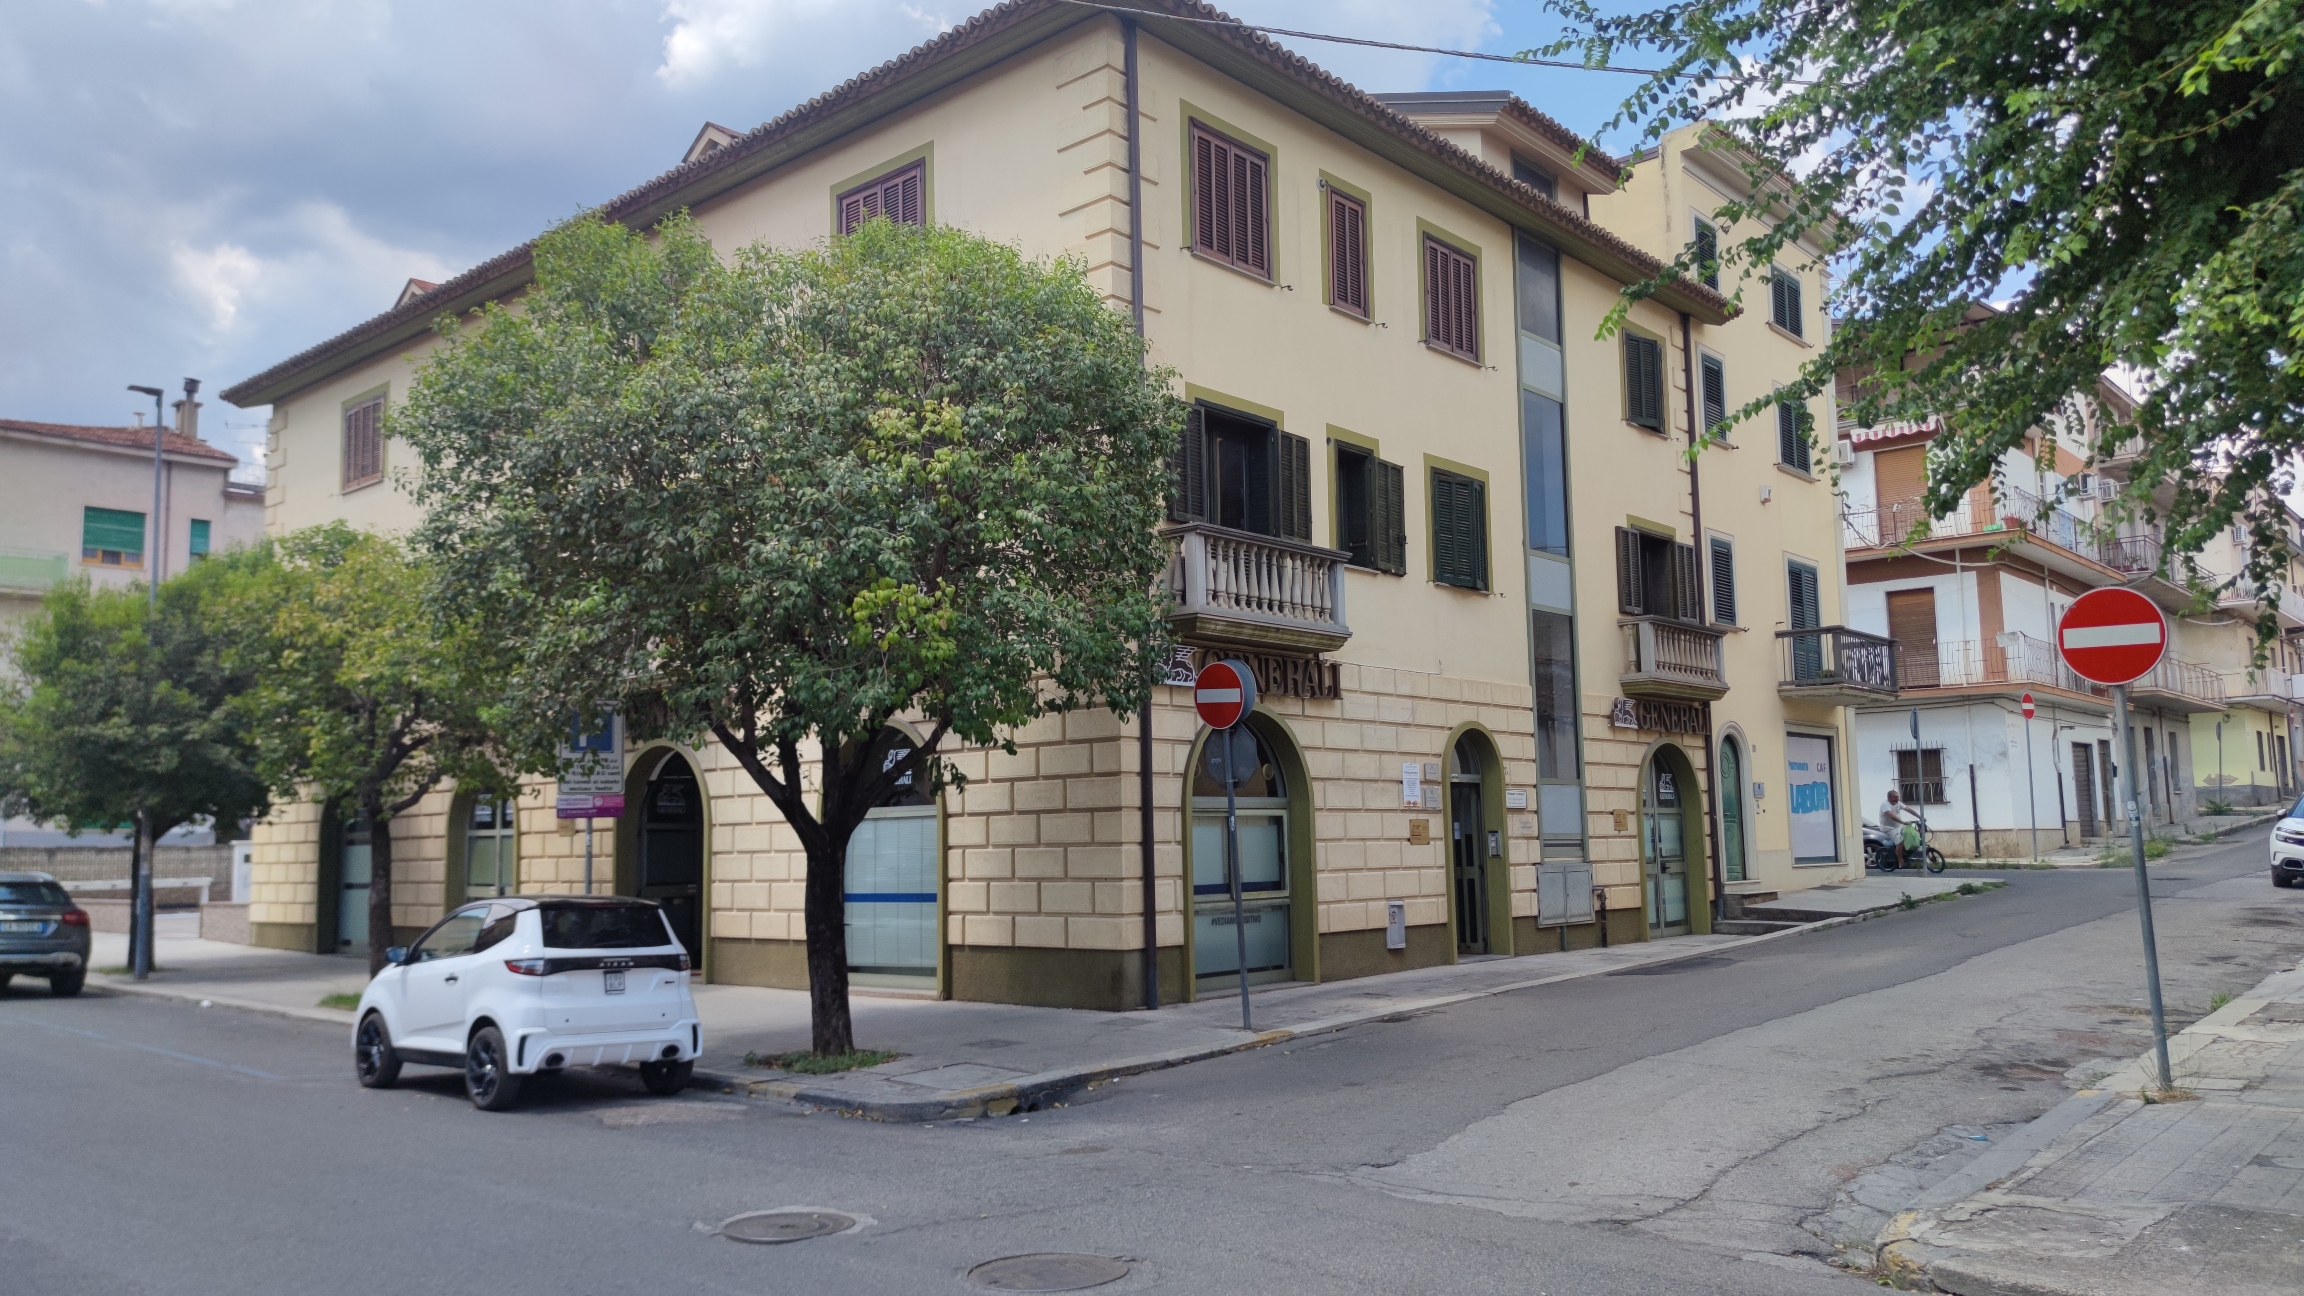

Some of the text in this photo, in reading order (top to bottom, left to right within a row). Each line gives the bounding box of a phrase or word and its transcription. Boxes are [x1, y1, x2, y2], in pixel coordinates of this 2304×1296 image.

[1201, 649, 1343, 700] GNERALI
[1639, 700, 1711, 735] GENERALI
[1816, 763, 1826, 773] CAF
[1789, 781, 1829, 814] LABOR
